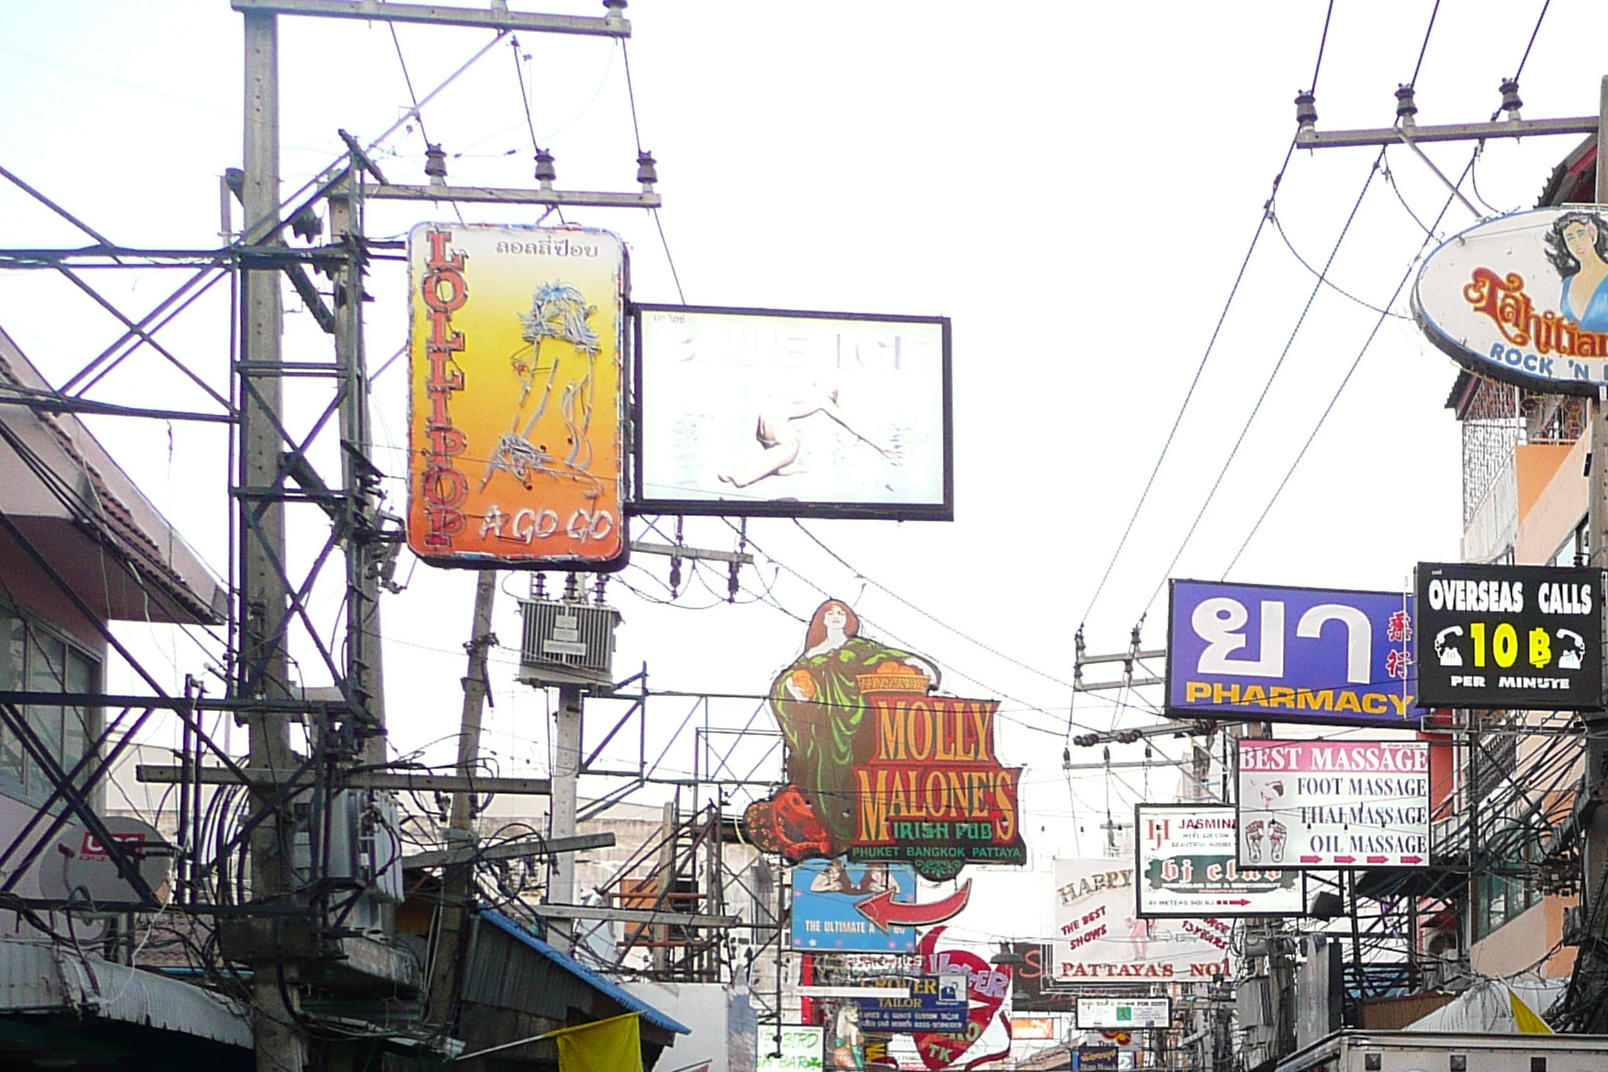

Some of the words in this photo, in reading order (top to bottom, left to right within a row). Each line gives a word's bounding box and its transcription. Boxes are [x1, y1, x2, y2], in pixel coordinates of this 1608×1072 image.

[1489, 342, 1554, 375] ROCK
[420, 230, 469, 549] LOLLIPOP
[479, 506, 506, 538] A
[565, 506, 613, 541] GO
[1428, 579, 1524, 613] OVERSEAS
[1537, 582, 1593, 615] CALLS
[1191, 597, 1373, 685] ยา
[1470, 622, 1519, 668] 10
[1450, 675, 1487, 688] PER
[1497, 676, 1571, 690] MINUTE
[1185, 681, 1415, 716] PHARMACY
[877, 700, 993, 761] MOLLY
[1239, 746, 1303, 772] BEST
[1310, 747, 1429, 772] MASSAGE
[1297, 777, 1344, 796] FOOT
[1348, 778, 1428, 797] MASSAGE
[857, 769, 1014, 841] MALONE'S
[1349, 806, 1428, 826] MASSAGE
[893, 822, 949, 840] IRISH
[955, 821, 993, 840] PUB
[852, 846, 900, 858] PHUKET
[906, 846, 966, 858] BANGKOK
[971, 846, 1021, 858] PATTAYA
[1309, 834, 1344, 854] OIL
[1349, 835, 1428, 855] MASSAGE
[1057, 868, 1134, 905] HAPPY
[805, 920, 821, 932] THE
[823, 920, 866, 934] ULTIMATE
[1060, 918, 1081, 937] THE
[1082, 905, 1107, 927] BEST
[1069, 924, 1108, 951] SHOWS
[1061, 961, 1174, 978] PATTAYA'S
[878, 998, 923, 1008] TAILOR
[783, 1032, 819, 1049] BIRD
